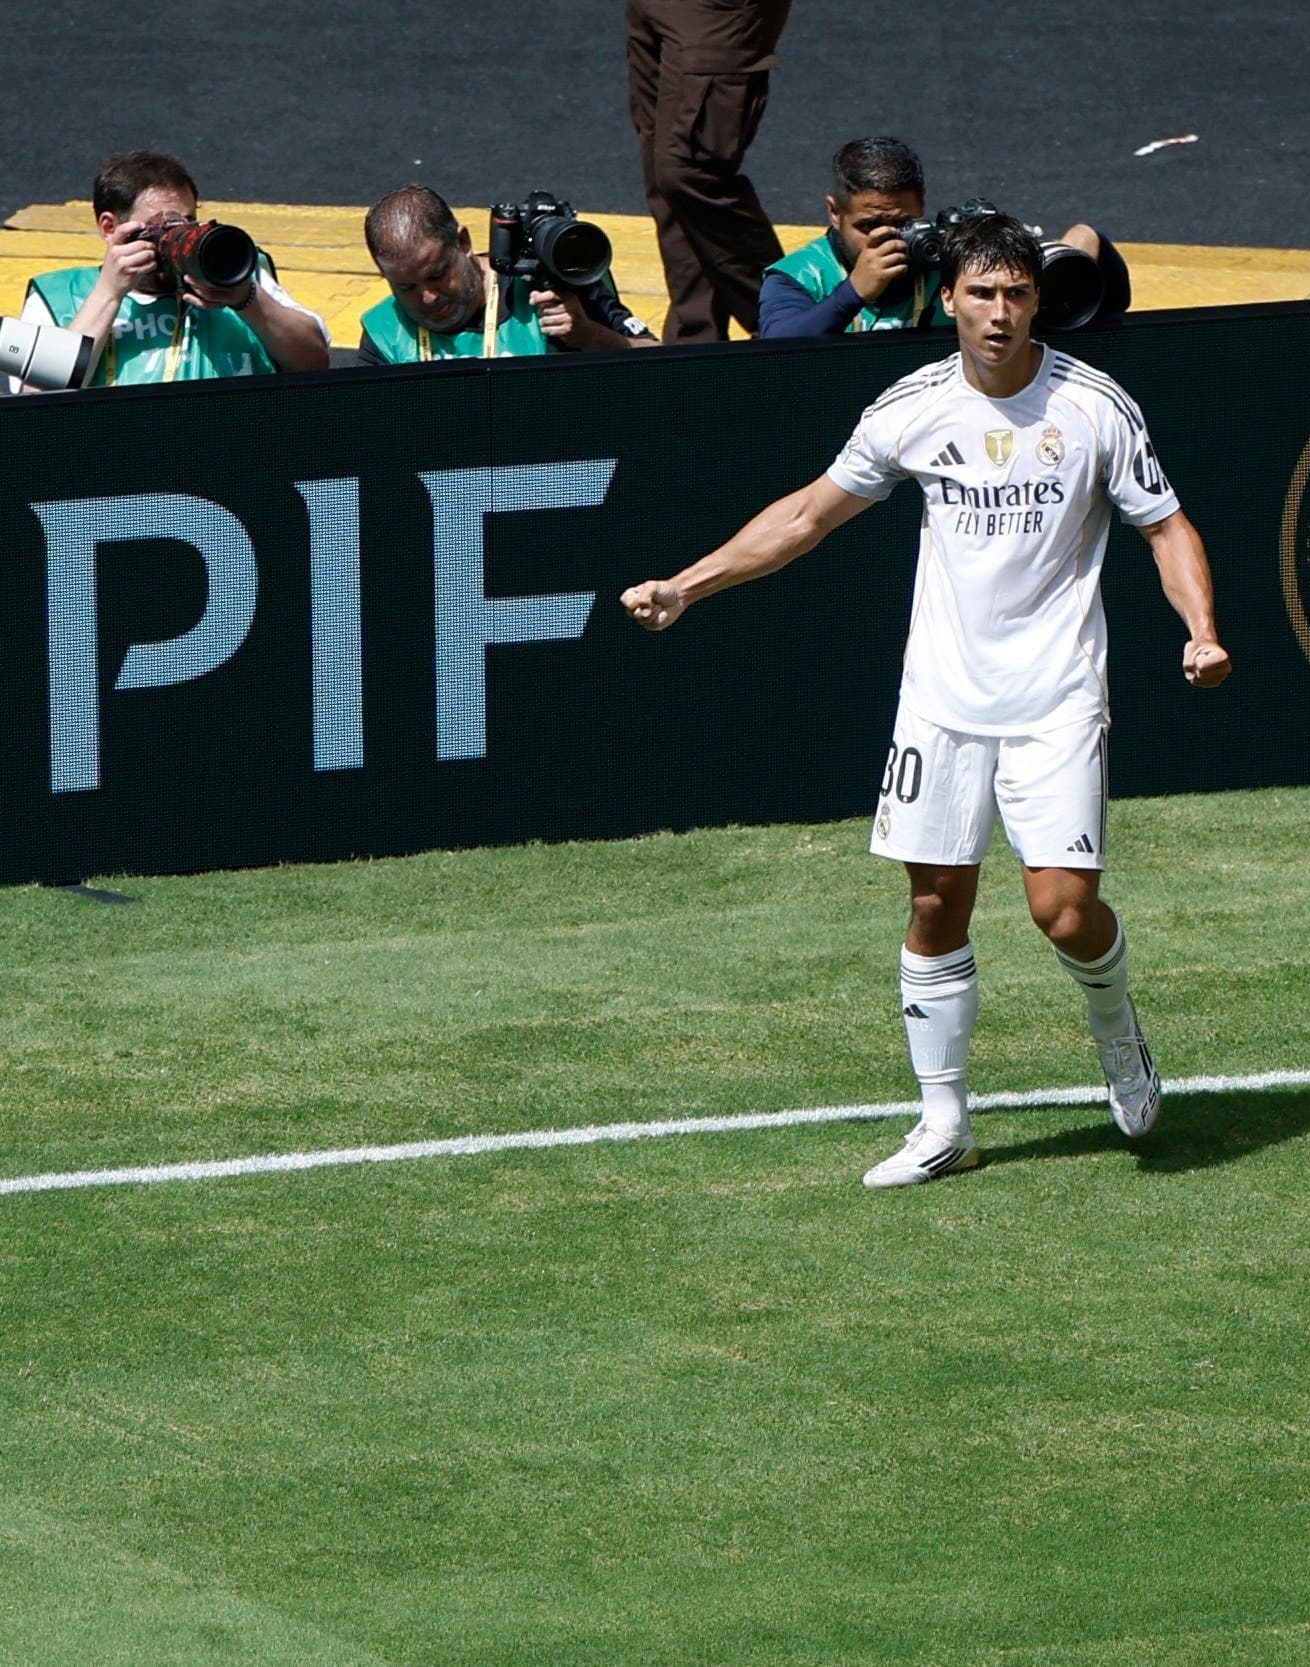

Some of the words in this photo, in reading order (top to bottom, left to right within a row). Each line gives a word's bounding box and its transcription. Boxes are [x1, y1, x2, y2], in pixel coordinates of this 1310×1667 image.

[940, 477, 1065, 509] Emirates
[986, 511, 1043, 537] BETTER
[28, 458, 618, 793] PIF
